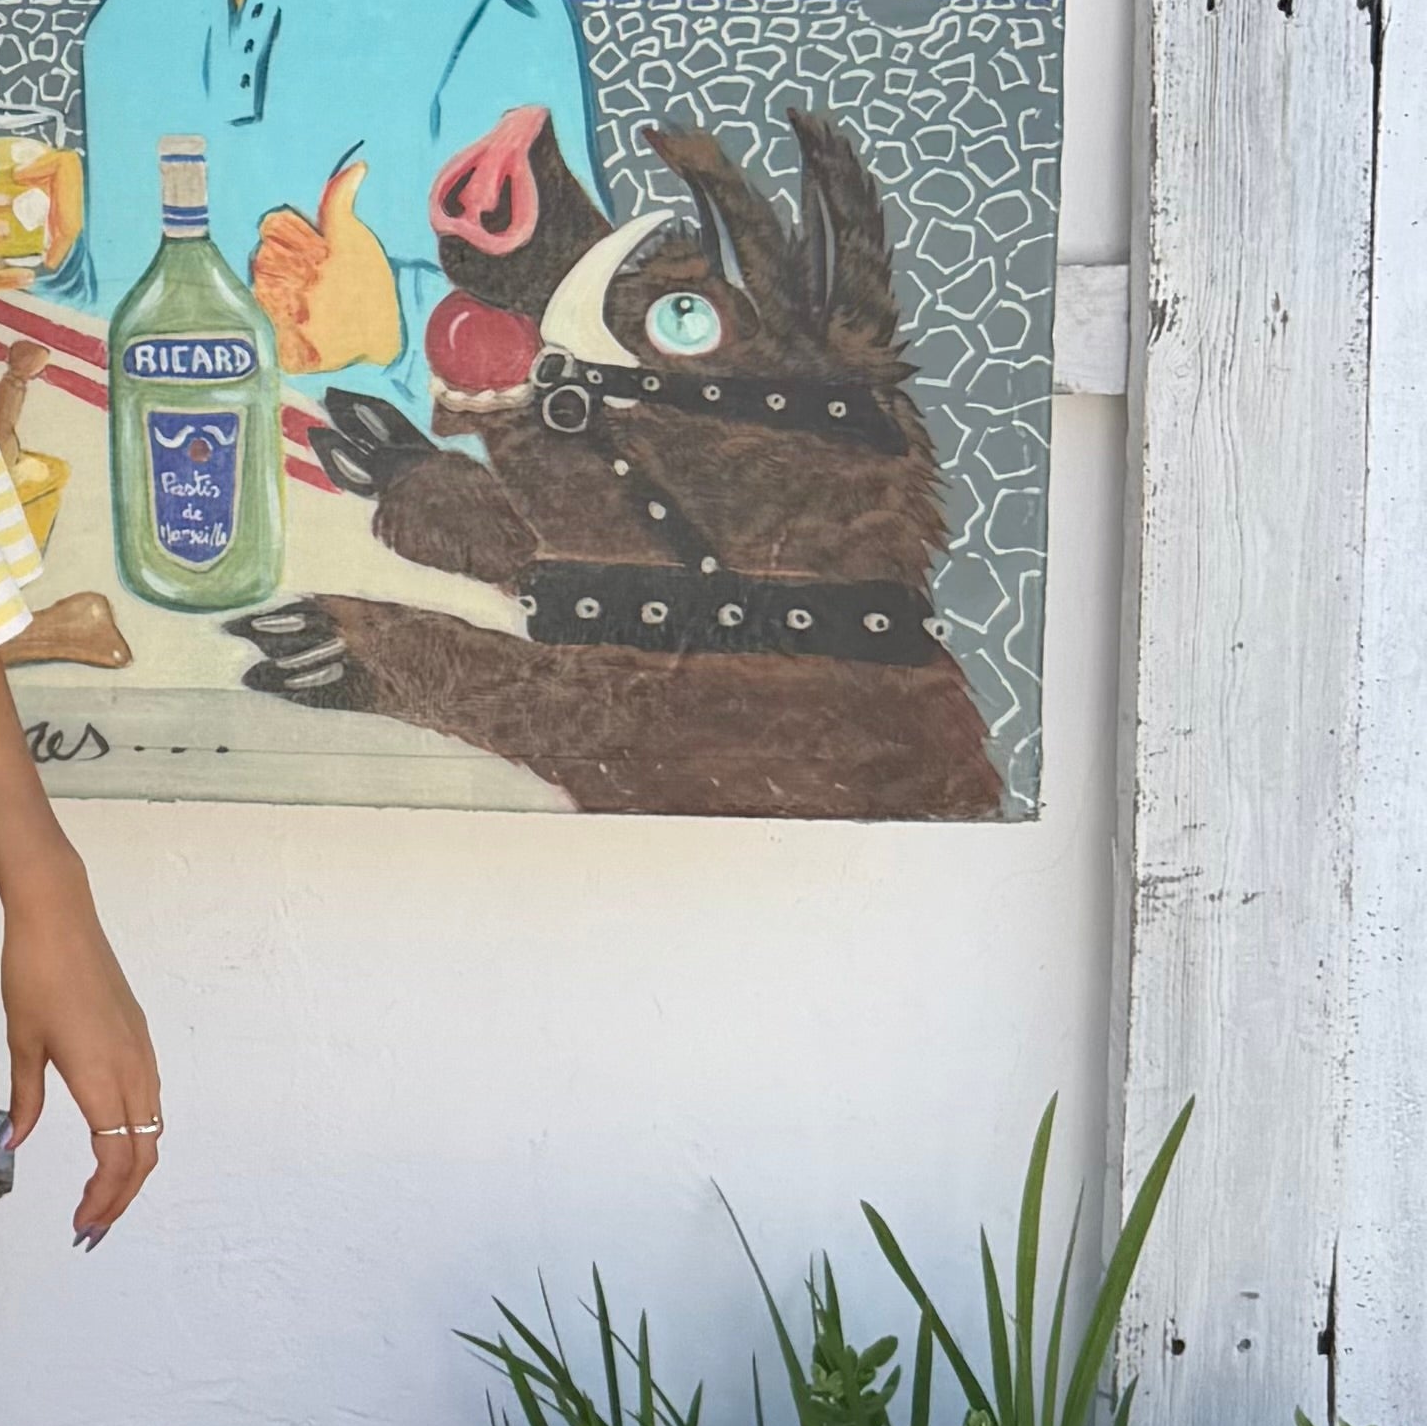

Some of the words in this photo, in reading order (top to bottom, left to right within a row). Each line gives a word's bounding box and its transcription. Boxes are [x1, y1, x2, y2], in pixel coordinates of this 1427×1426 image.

[134, 344, 252, 374] RICARD
[160, 469, 222, 499] Pastis
[181, 502, 204, 522] de
